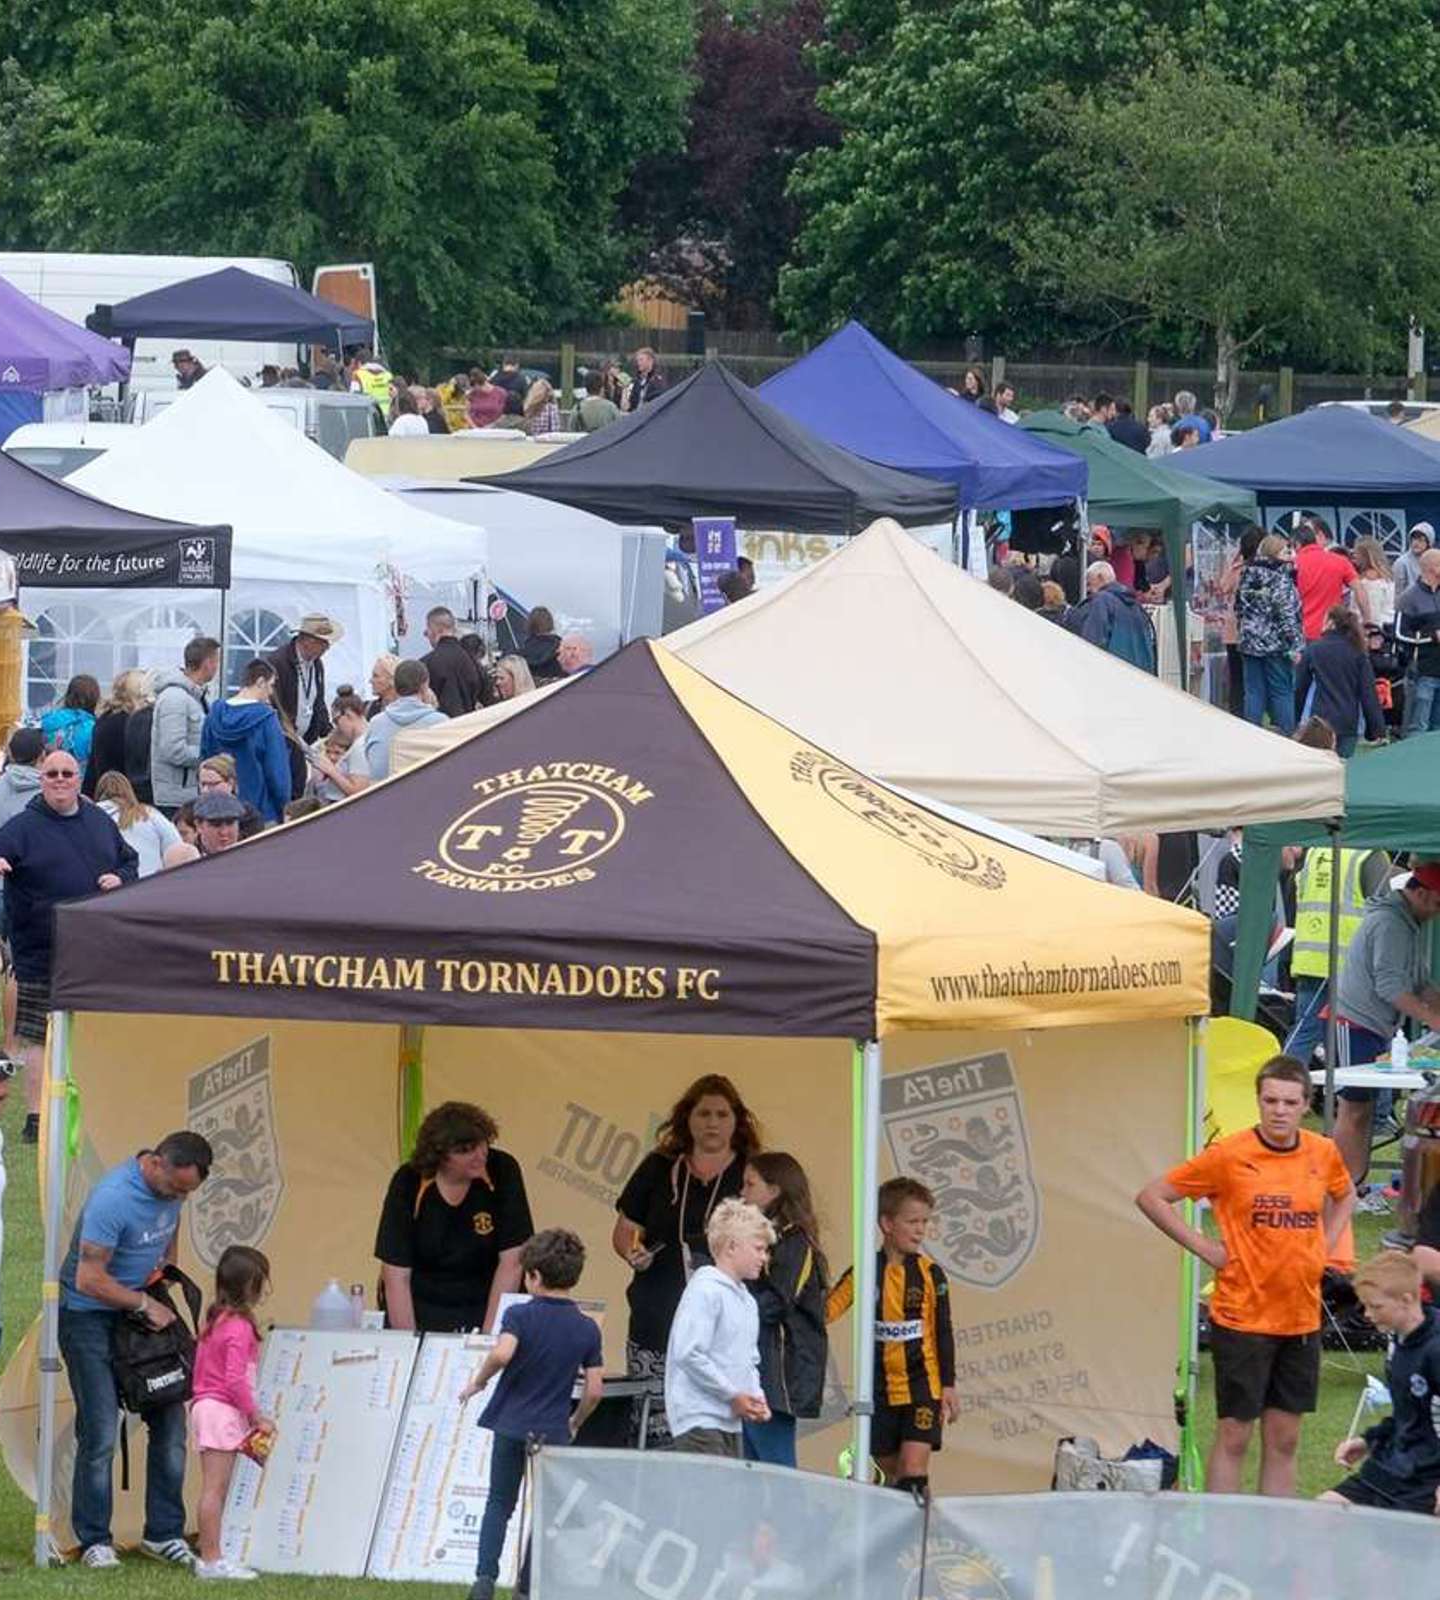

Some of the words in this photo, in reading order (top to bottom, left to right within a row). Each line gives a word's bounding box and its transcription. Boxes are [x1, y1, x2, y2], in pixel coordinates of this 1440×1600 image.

[15, 552, 57, 574] ildlife
[58, 553, 83, 575] for
[85, 554, 111, 572] the
[113, 554, 166, 574] future
[472, 761, 656, 806] THATCHAM
[456, 824, 503, 850] T
[558, 828, 607, 855] T
[411, 859, 597, 892] TORNADOES
[210, 950, 426, 992] THATCHAM
[435, 958, 667, 999] TORNADOES
[676, 966, 721, 1000] FC
[930, 954, 1183, 1002] www.thatchamtornadoes.com
